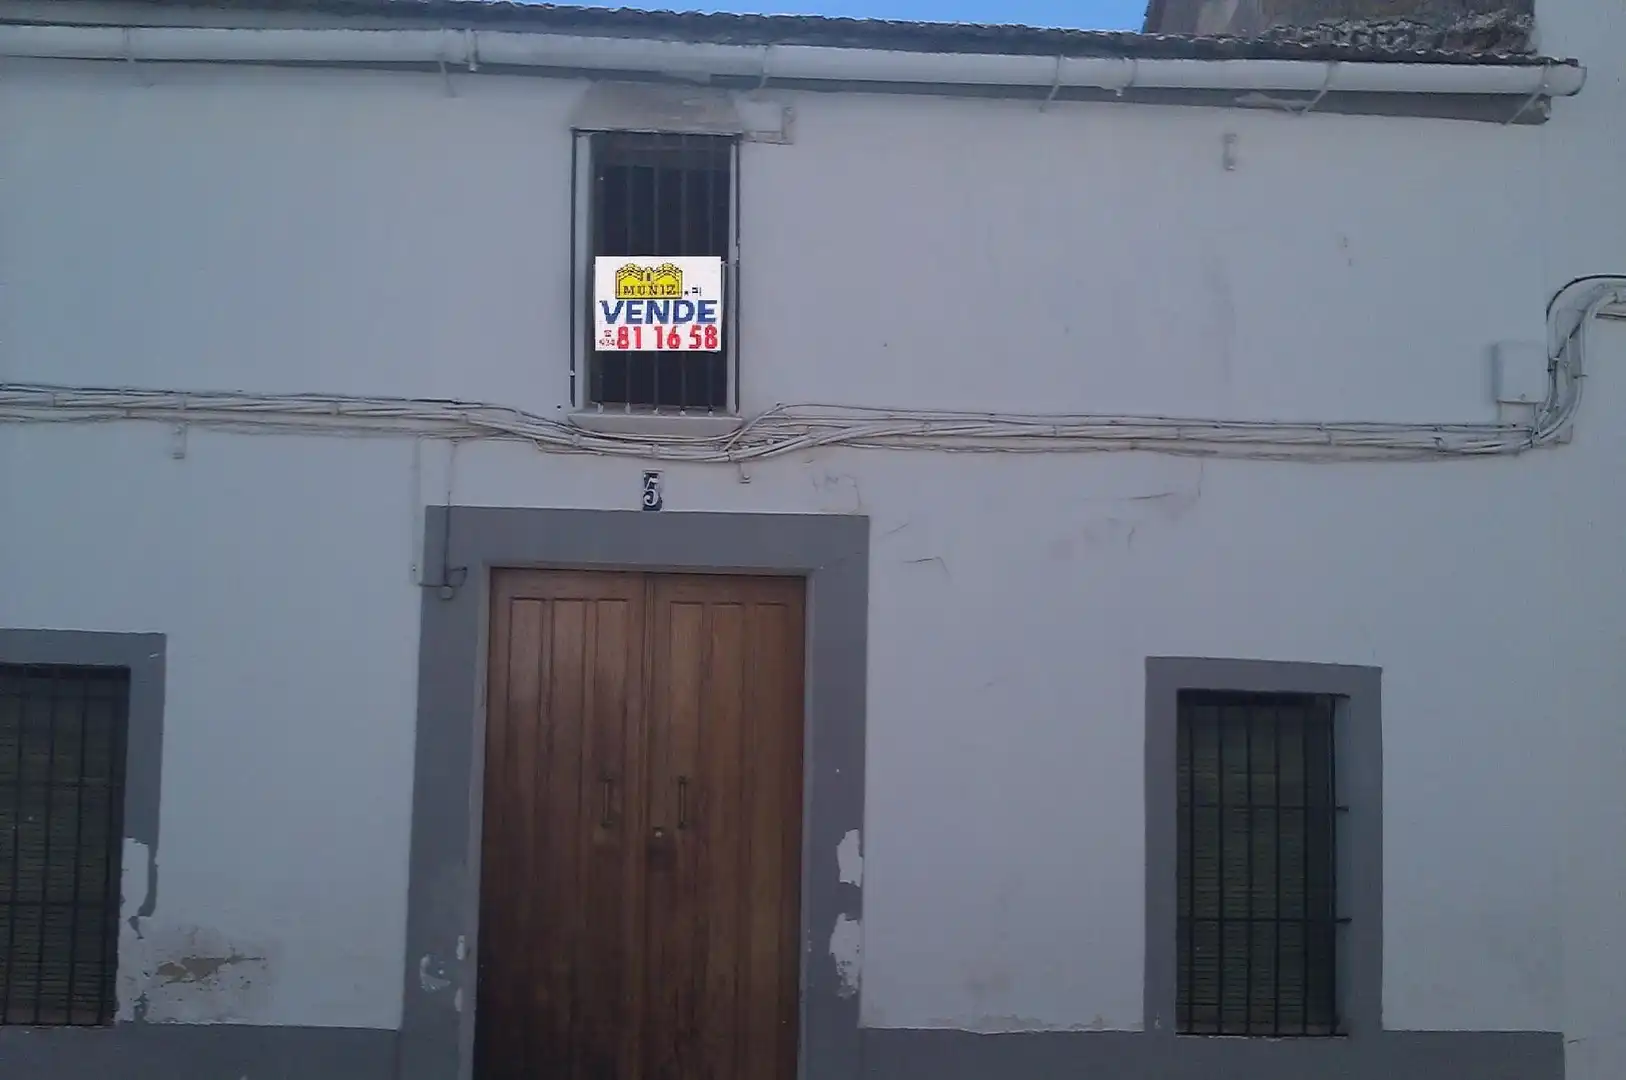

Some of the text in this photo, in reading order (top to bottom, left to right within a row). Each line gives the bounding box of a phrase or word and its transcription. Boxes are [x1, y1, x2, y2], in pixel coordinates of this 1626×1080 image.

[599, 299, 718, 325] VENDE
[616, 326, 642, 349] 81
[653, 325, 681, 349] 16
[688, 324, 718, 349] 58
[643, 477, 660, 506] 5
